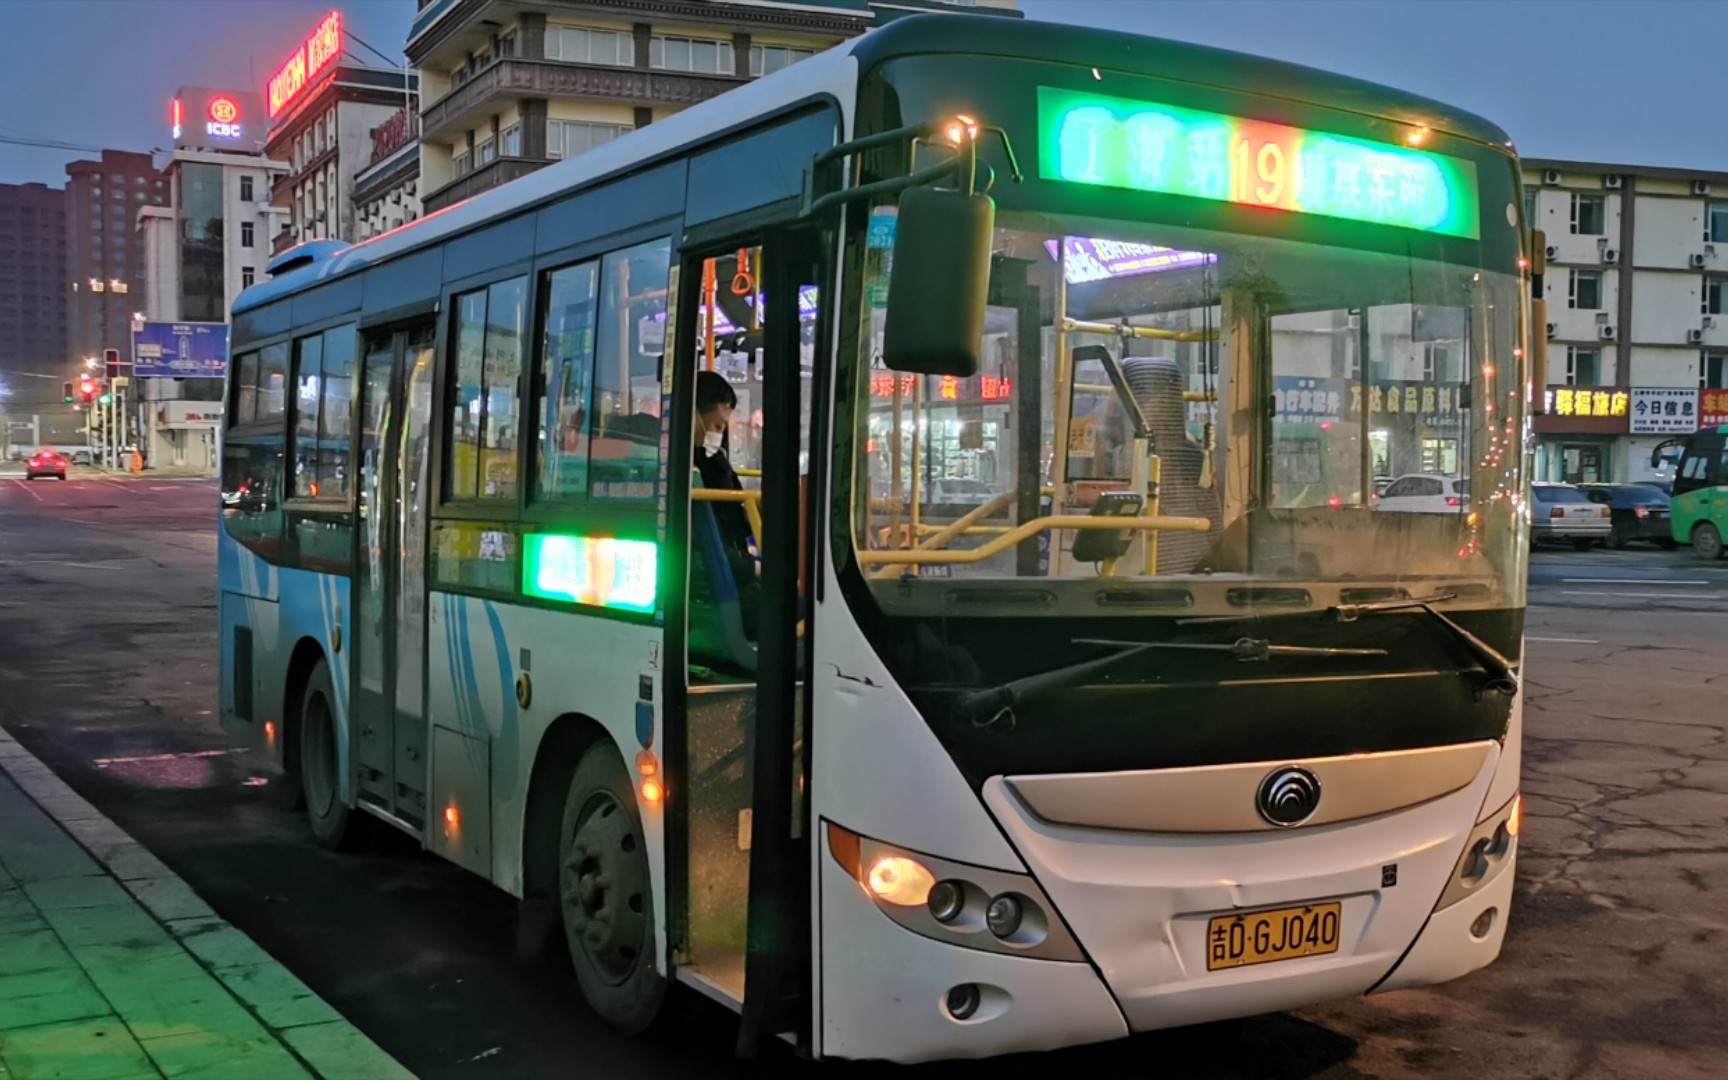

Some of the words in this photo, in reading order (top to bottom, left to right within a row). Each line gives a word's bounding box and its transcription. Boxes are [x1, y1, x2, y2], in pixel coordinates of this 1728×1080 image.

[207, 122, 241, 137] ICBC
[1233, 139, 1285, 205] 19
[1556, 390, 1628, 416] 驿福旅店
[1634, 400, 1694, 416] 今日信息
